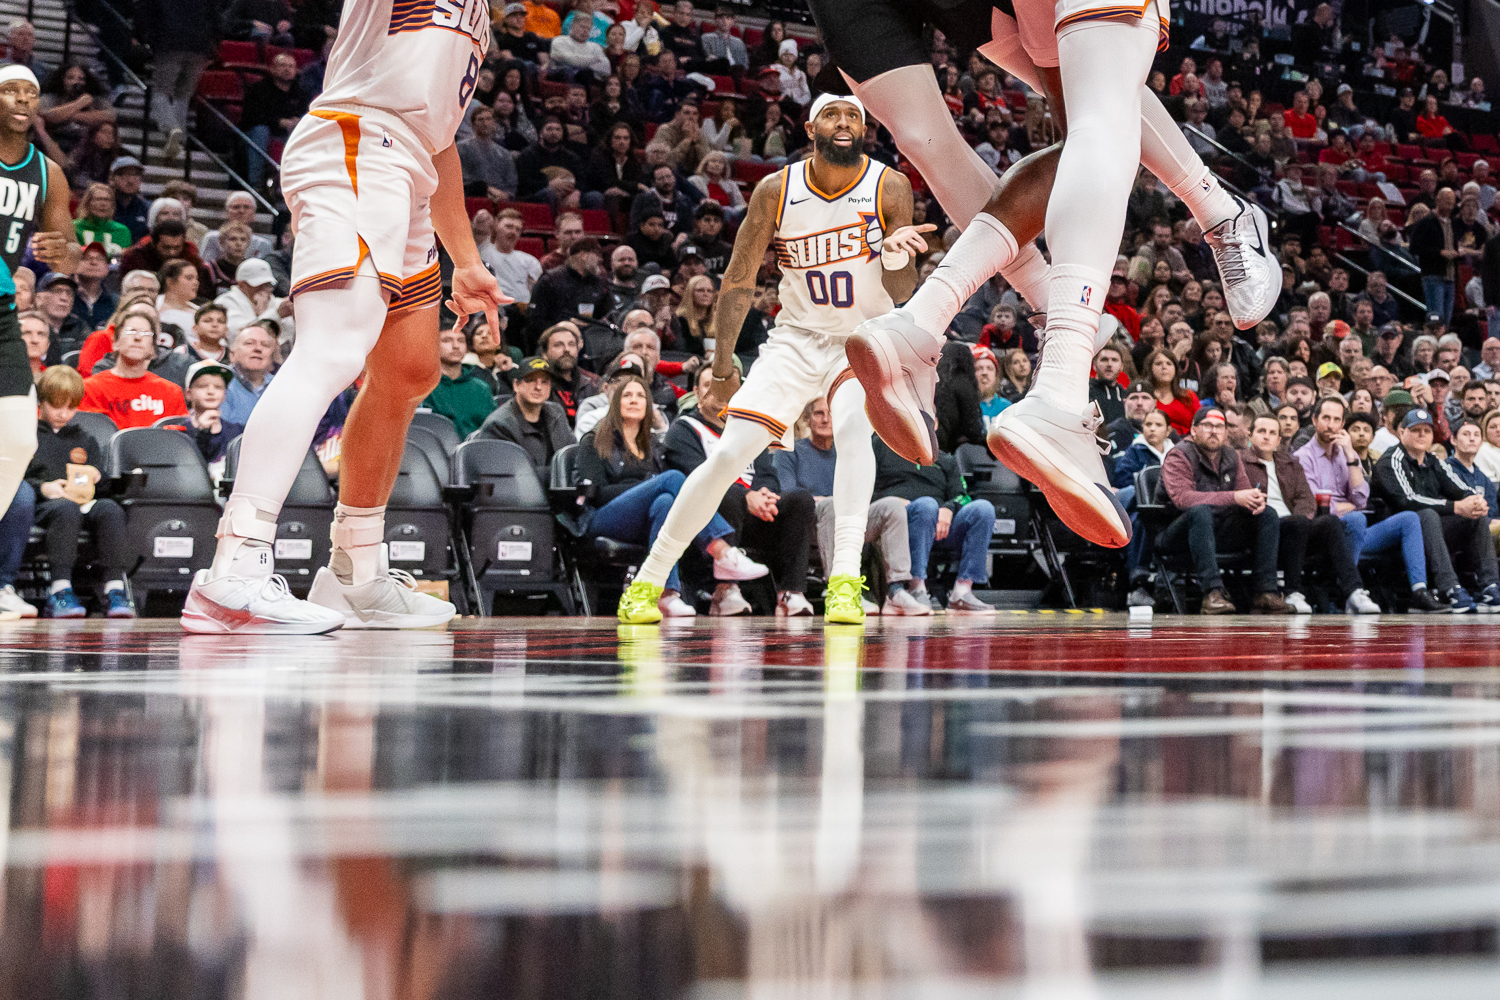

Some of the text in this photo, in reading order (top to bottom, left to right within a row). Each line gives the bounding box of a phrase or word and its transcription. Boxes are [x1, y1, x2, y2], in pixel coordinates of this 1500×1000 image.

[459, 51, 479, 110] 8
[0, 176, 39, 221] DX
[5, 221, 24, 254] 5
[786, 226, 862, 268] SUNS
[806, 270, 854, 308] 00
